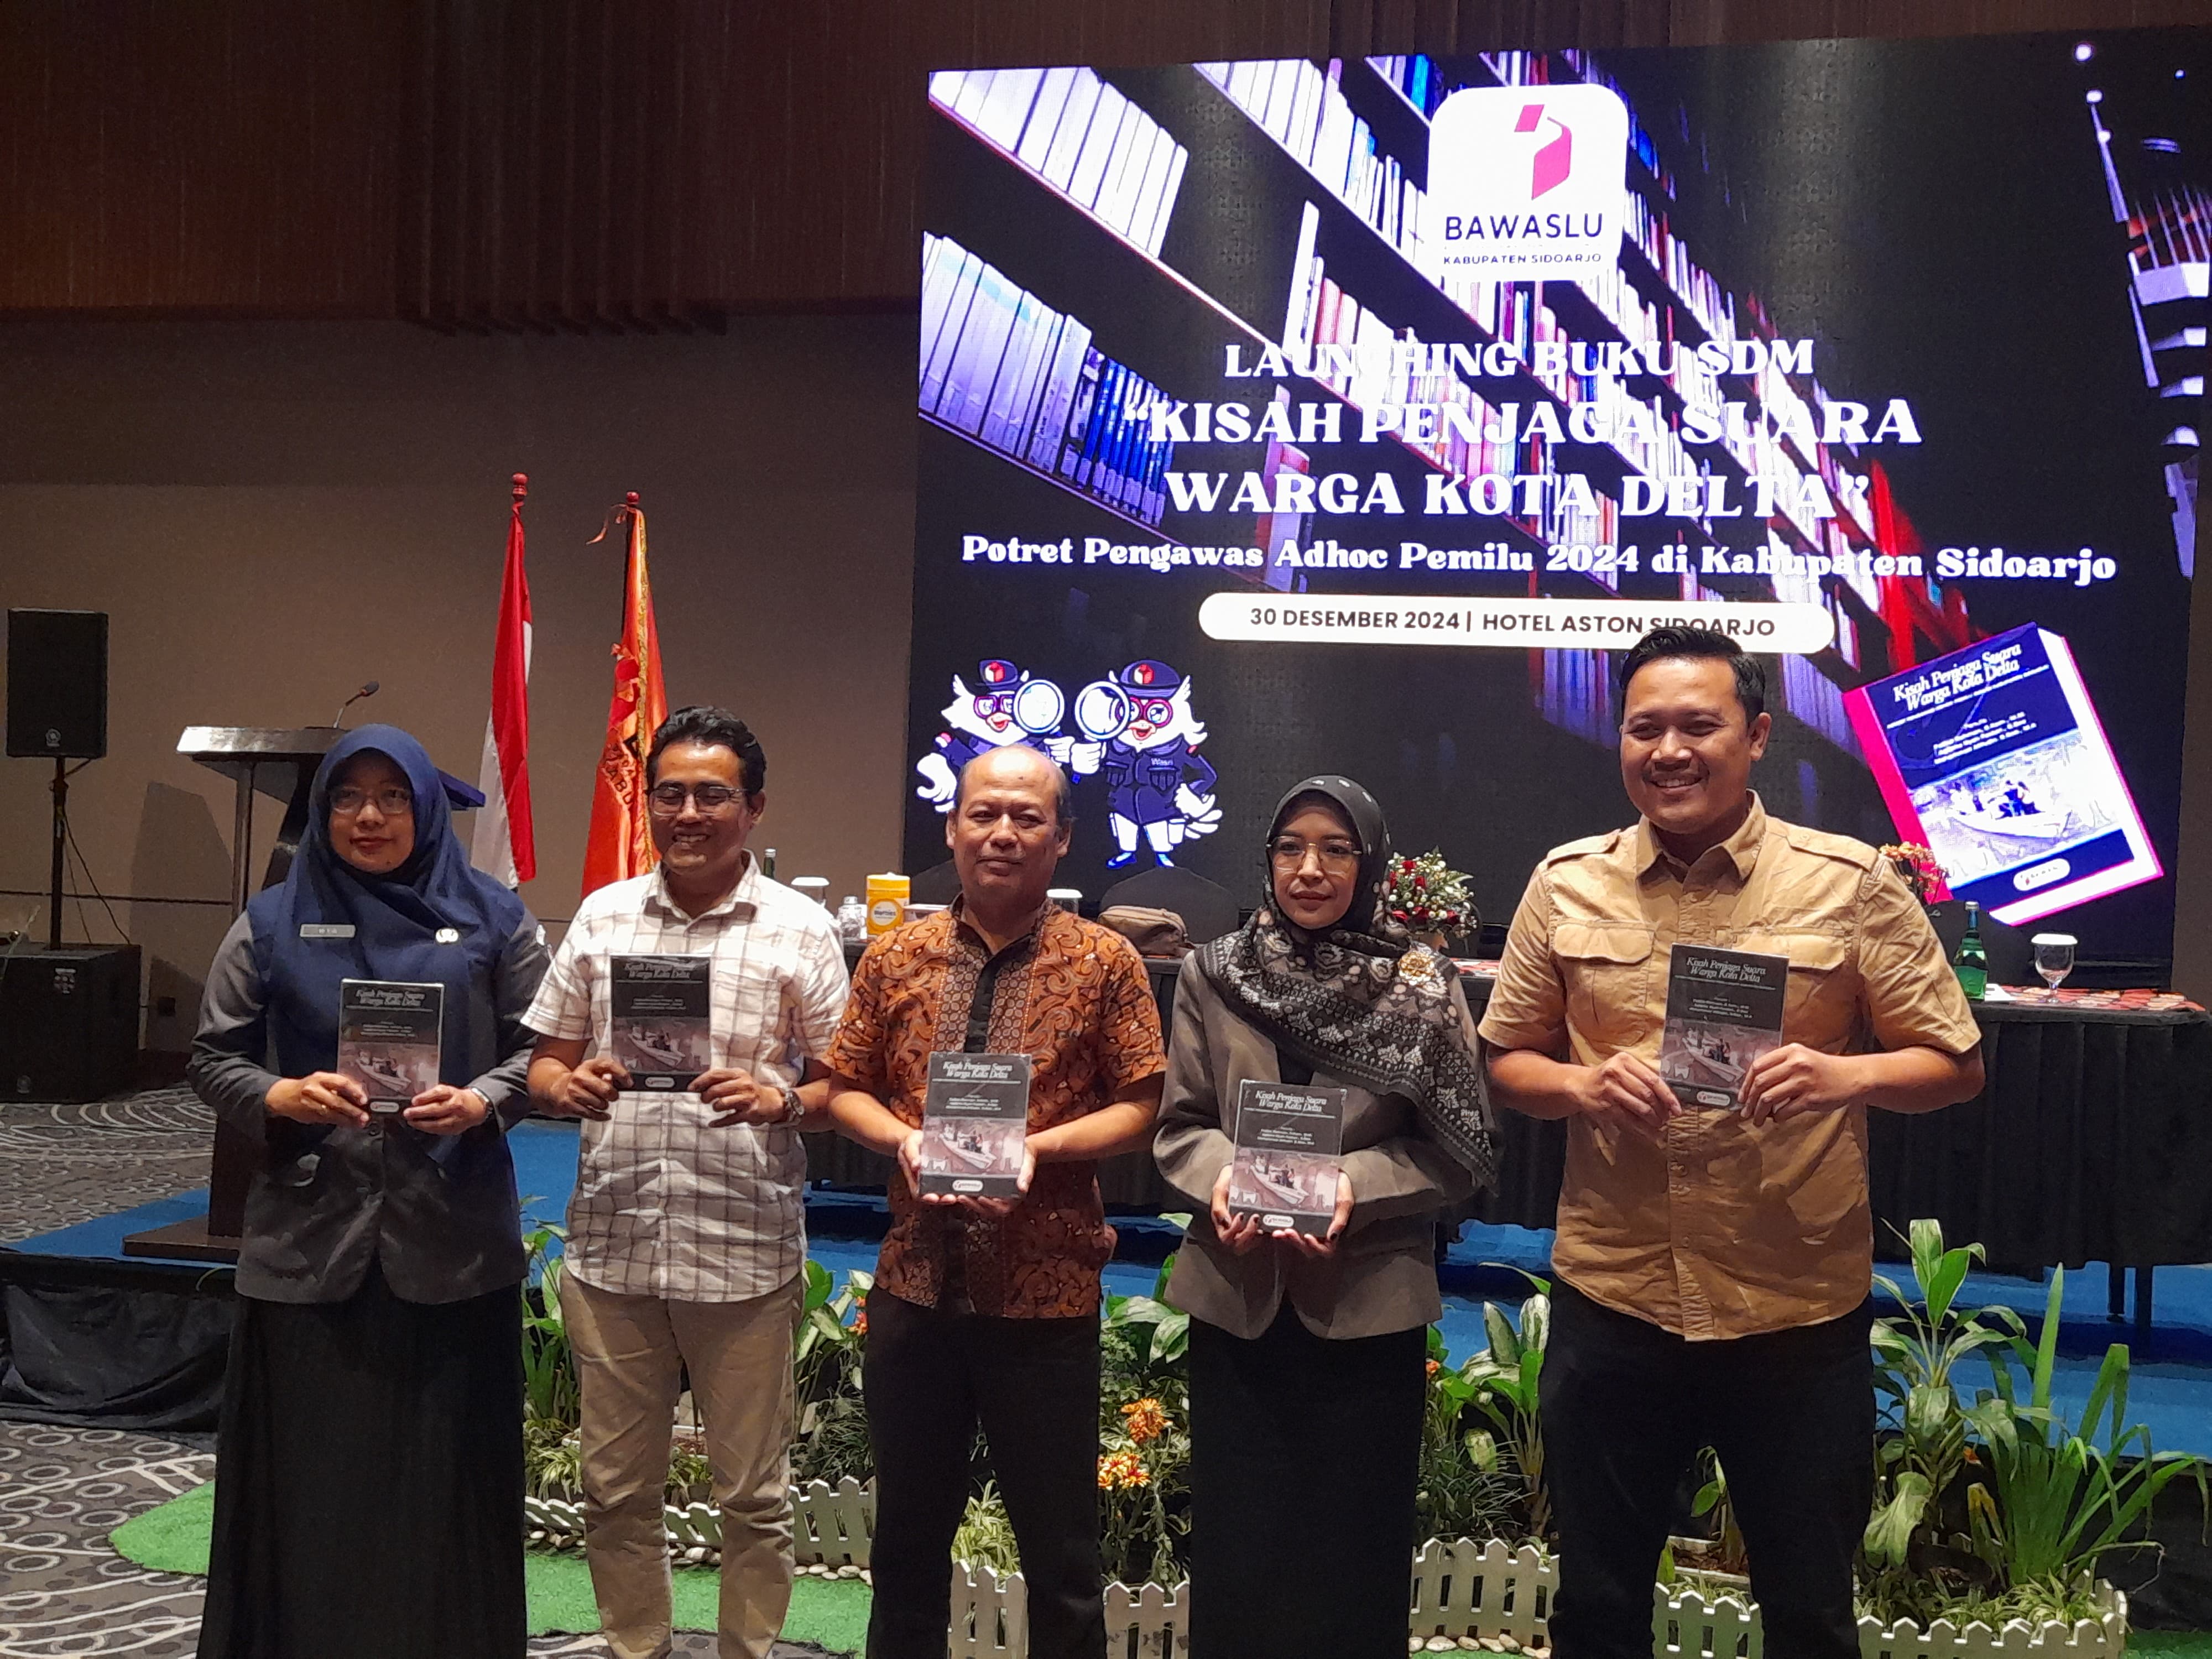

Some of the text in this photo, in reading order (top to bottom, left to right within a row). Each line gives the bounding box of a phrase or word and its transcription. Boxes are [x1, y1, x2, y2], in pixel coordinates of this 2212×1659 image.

[1446, 213, 1602, 239] BAWASLU
[1444, 253, 1601, 264] KABUPATEN SIDOARJO
[1225, 339, 1814, 377] LAUNHING BUKU SDM
[1359, 401, 1660, 443] PENJAGA
[1681, 399, 1922, 444] SUARA
[1164, 472, 1405, 514] WARGA
[1424, 473, 1600, 515] KOTA
[962, 535, 2116, 586] Potret Pengawas Adhoc Pemilu 2024 di Kabupaten Sidoarjo
[1250, 608, 1277, 625] 30
[1284, 609, 1398, 629] DESEMBER
[1483, 614, 1555, 632] HOTEL
[1562, 615, 1642, 633] ASTON
[1893, 676, 1931, 702] Kisah
[1982, 644, 2022, 664] Suara
[1907, 686, 1951, 711] Warga
